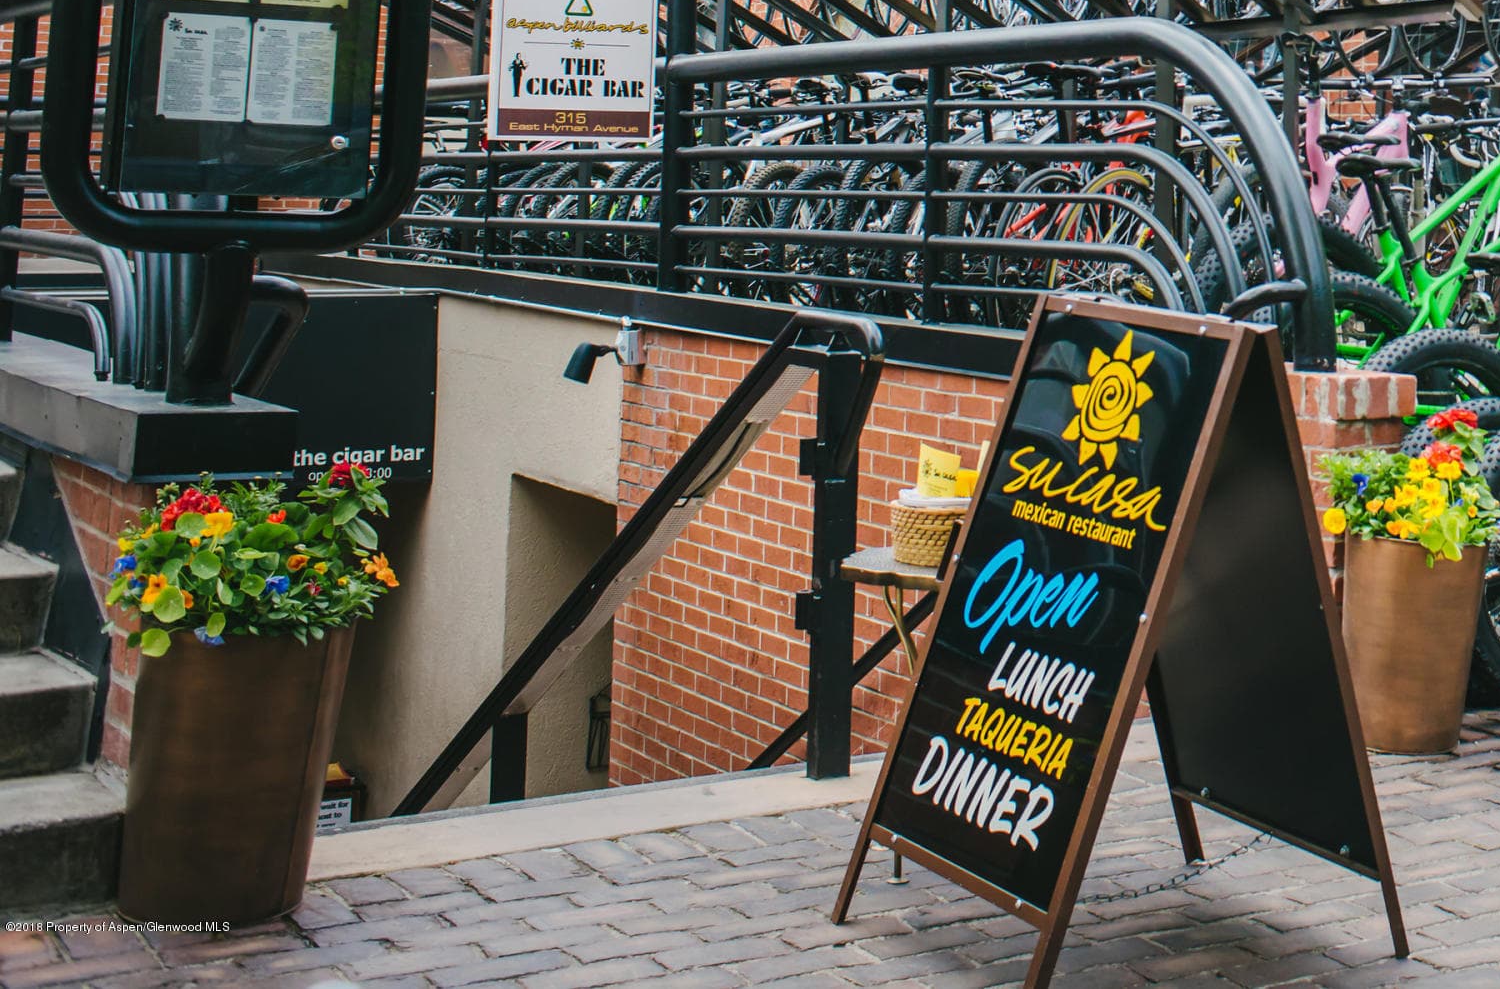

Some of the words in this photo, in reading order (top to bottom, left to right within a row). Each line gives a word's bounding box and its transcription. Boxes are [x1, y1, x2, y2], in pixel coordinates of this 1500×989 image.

[526, 77, 593, 97] CIGAR
[603, 79, 645, 98] BAR
[560, 57, 606, 77] THE
[509, 122, 540, 131] East
[544, 122, 589, 132] Hyman
[593, 123, 639, 133] Avenue
[555, 112, 587, 125] 315
[293, 449, 327, 467] the
[332, 446, 385, 465] cigar
[390, 444, 425, 462] bar
[1011, 499, 1066, 531] mexican
[1066, 513, 1137, 550] restaurant
[1065, 466, 1167, 532] casa
[963, 538, 1100, 655] Open
[988, 641, 1095, 724] LUNCH
[955, 697, 1075, 781] TAQUERIA
[912, 735, 1055, 852] DINNER
